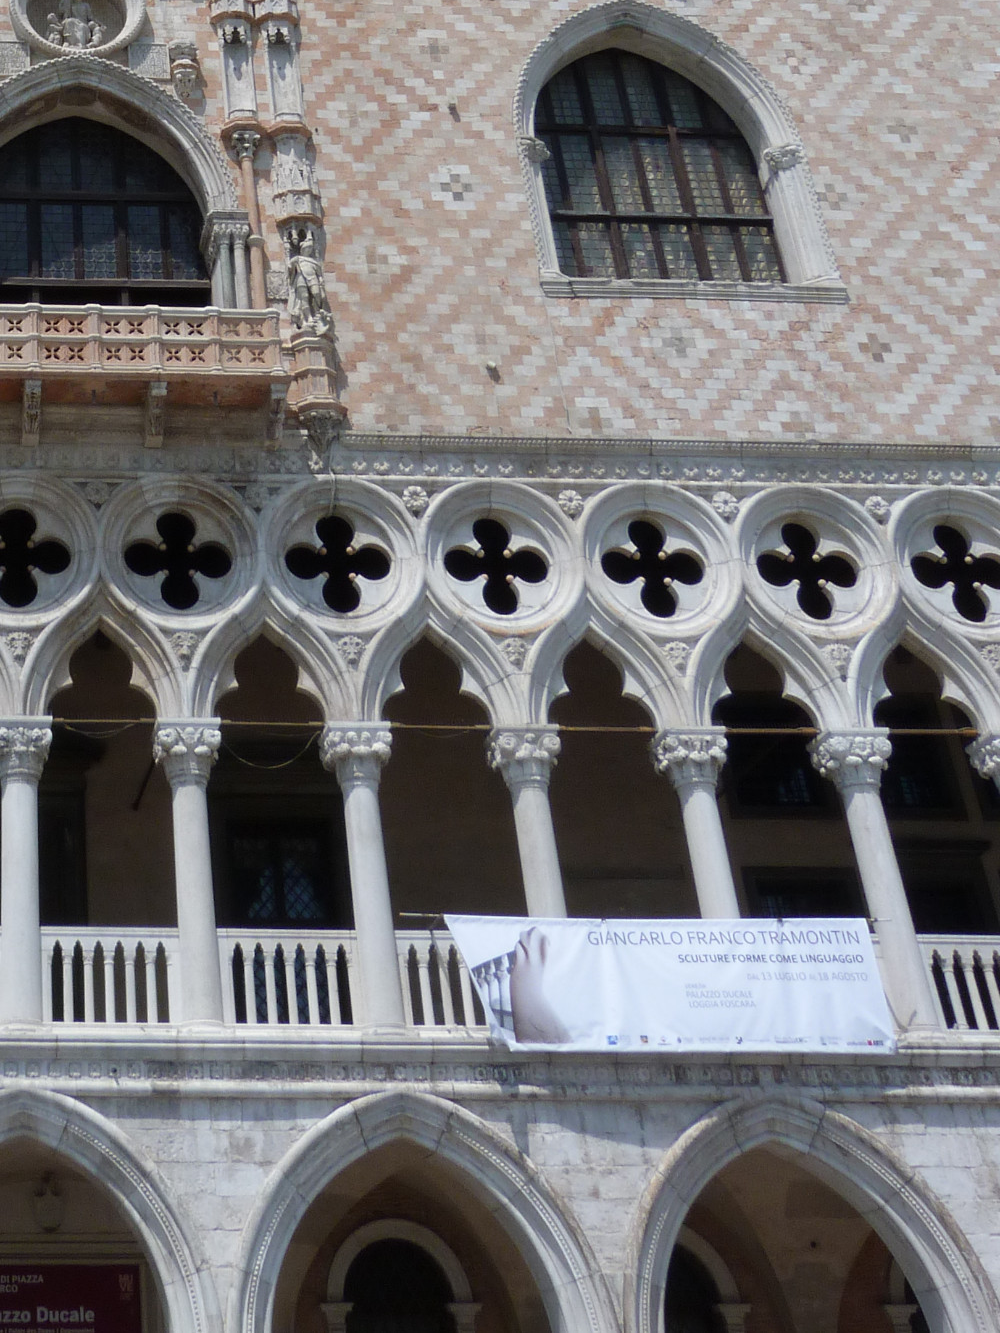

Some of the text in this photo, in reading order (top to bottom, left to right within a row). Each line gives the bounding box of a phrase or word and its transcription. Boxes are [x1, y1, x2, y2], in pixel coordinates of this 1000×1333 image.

[587, 930, 860, 946] GIANCARLO FRANCO TRAMONTIN
[678, 954, 864, 964] SCULTURE FORME COME LINGUAGGIO
[761, 972, 772, 980] 13
[774, 972, 807, 981] LUGLIO
[818, 972, 829, 981] 18
[831, 972, 869, 982] AGOSTO
[685, 990, 753, 998] PALAZZO DUCALE
[689, 1000, 757, 1008] LOGGIA FOSCARA
[0, 1275, 10, 1283] DI
[11, 1275, 44, 1283] PIAZZA
[36, 1305, 95, 1323] Ducale
